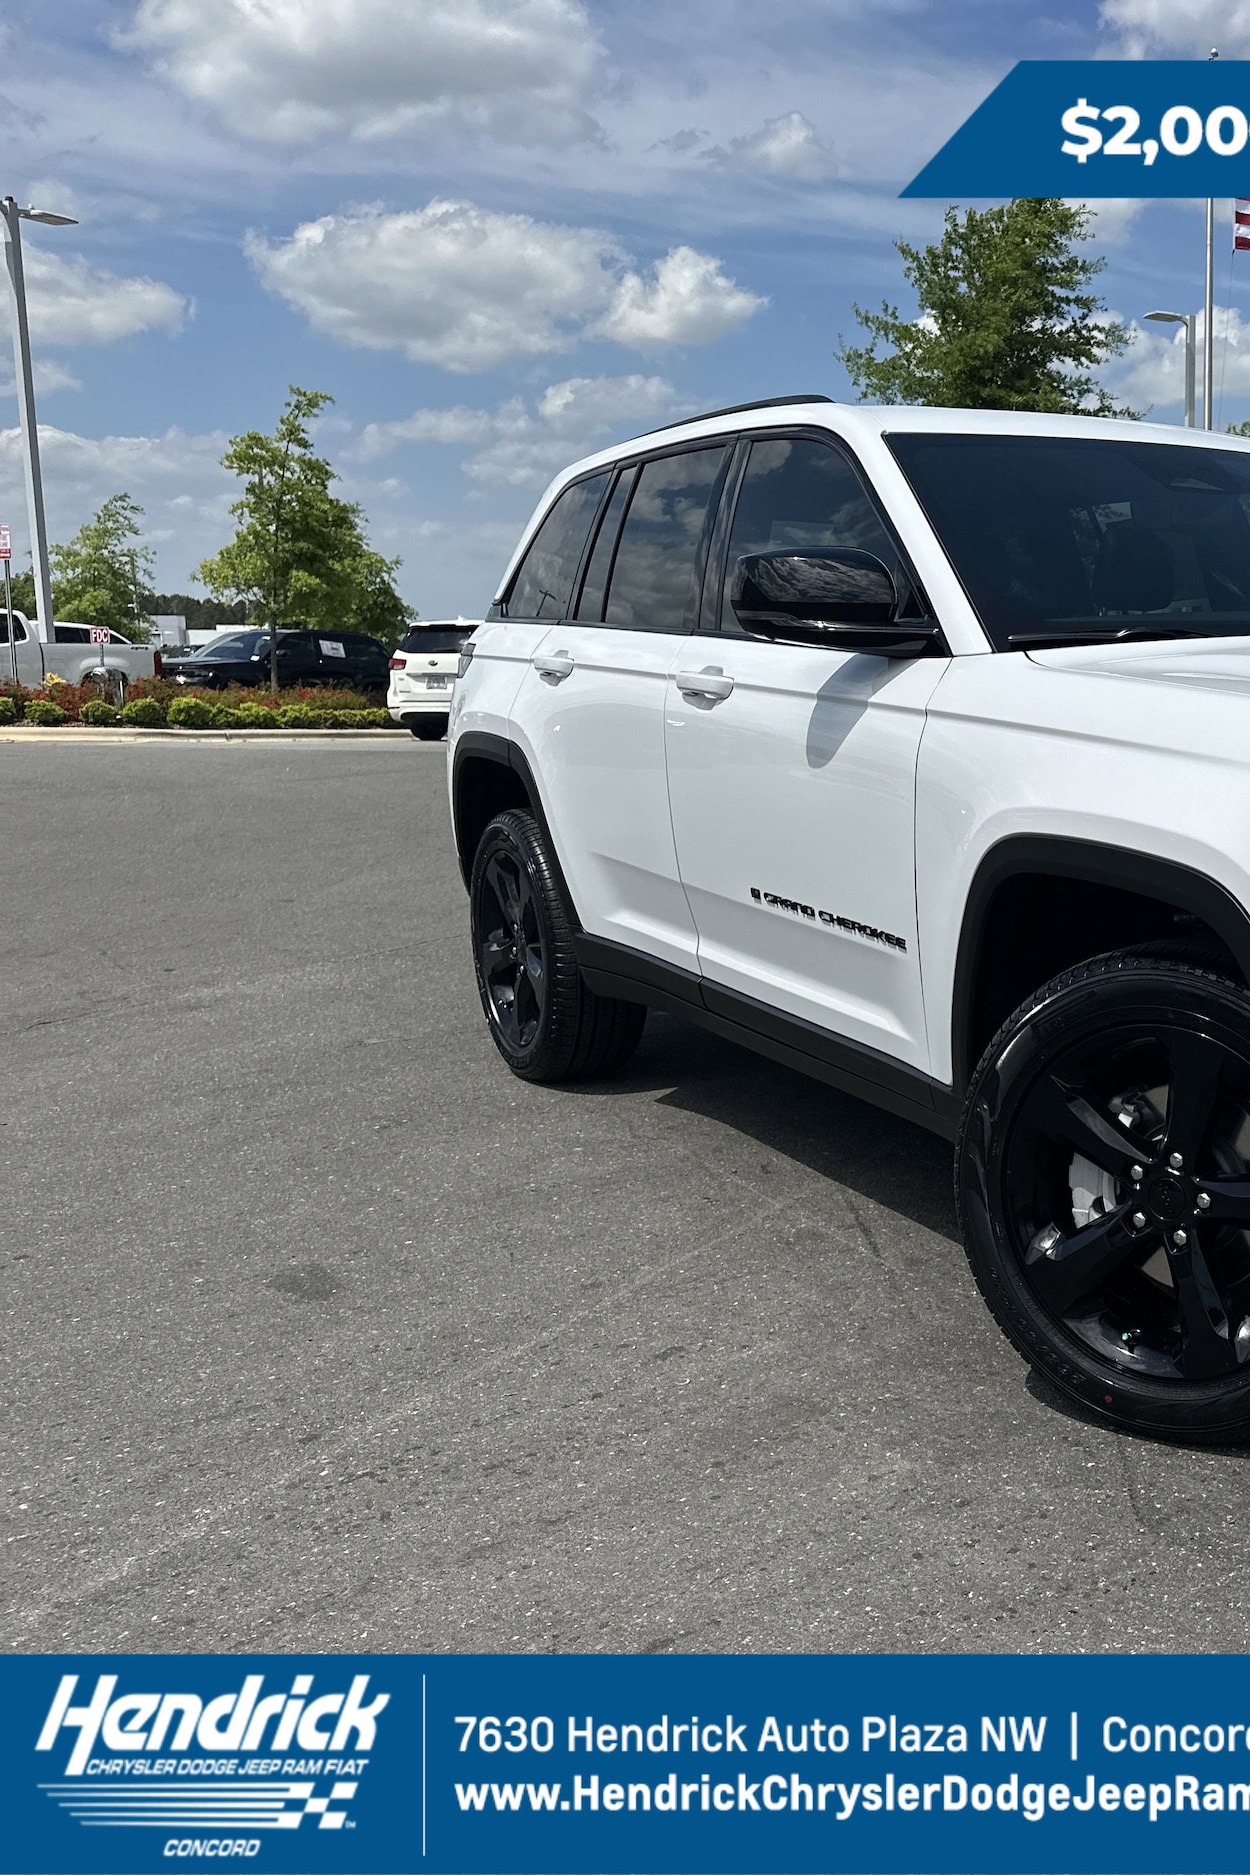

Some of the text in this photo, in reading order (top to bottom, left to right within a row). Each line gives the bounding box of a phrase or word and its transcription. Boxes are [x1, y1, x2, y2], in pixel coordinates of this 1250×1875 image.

[91, 629, 109, 643] FDC
[764, 892, 907, 951] GRAND CHEROKEE
